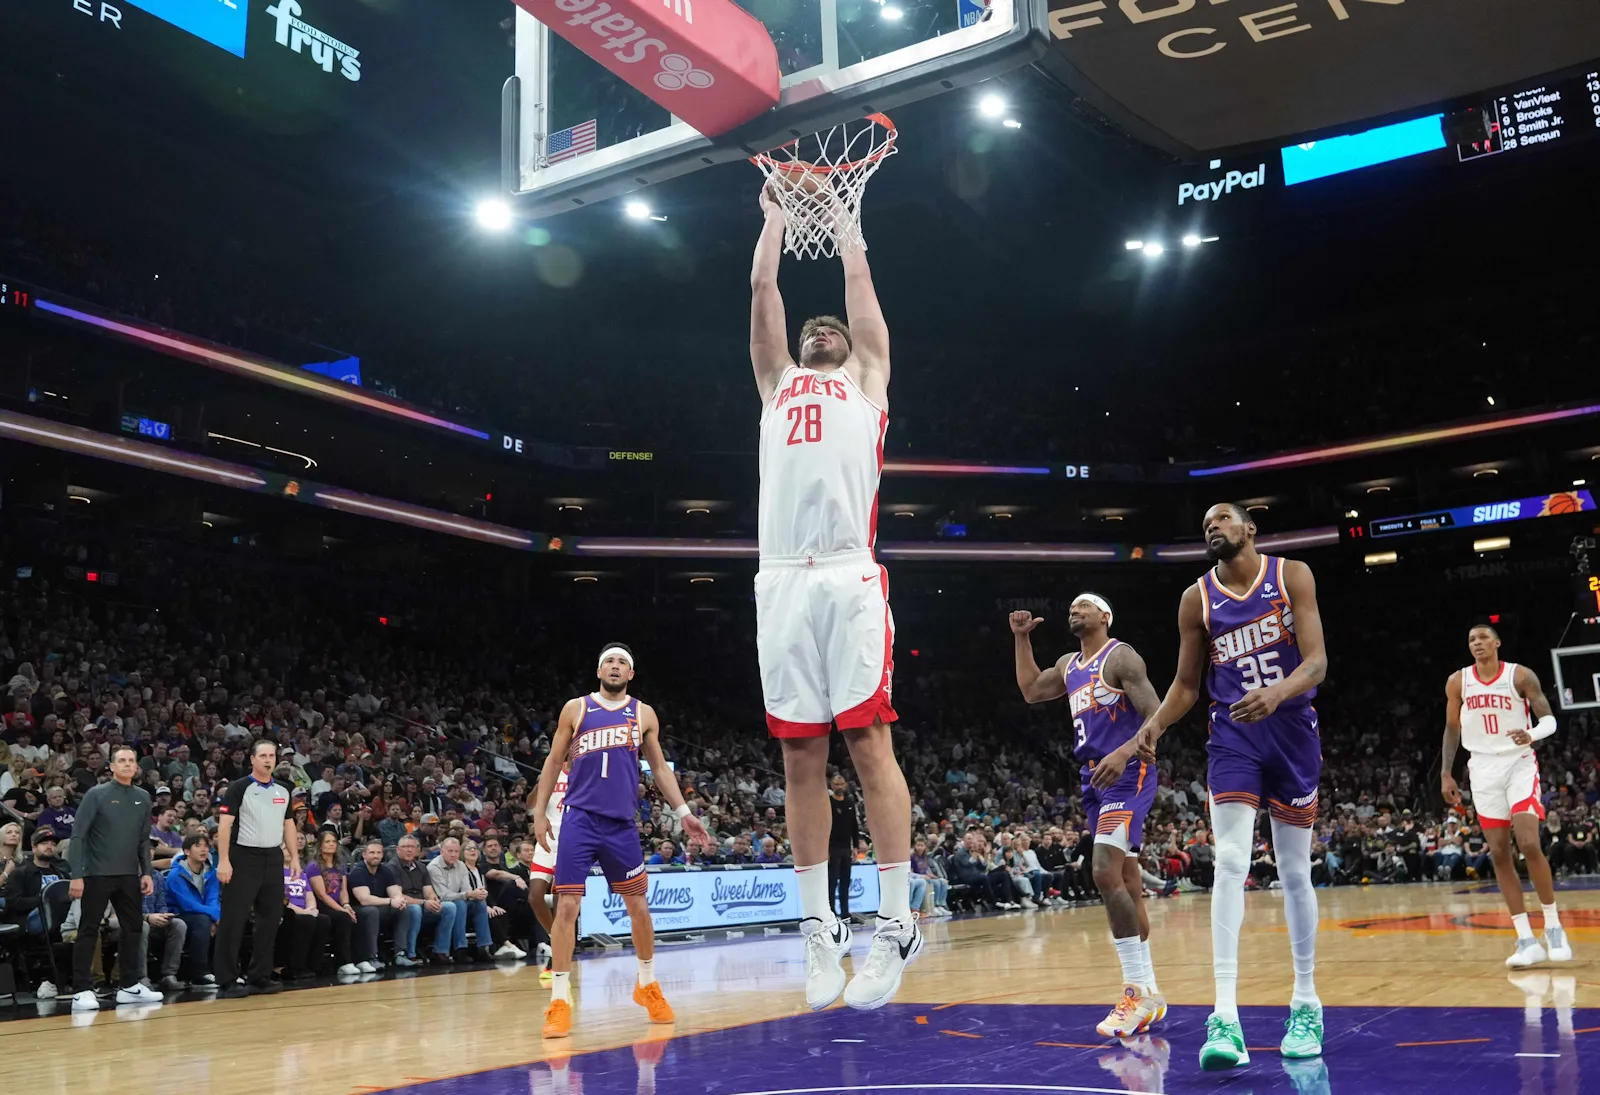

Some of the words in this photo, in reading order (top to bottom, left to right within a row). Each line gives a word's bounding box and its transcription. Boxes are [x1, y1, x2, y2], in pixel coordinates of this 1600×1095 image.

[265, 0, 361, 82] fry's
[291, 18, 317, 37] FOOD
[320, 33, 355, 57] STORES
[1500, 103, 1509, 115] 5
[1514, 91, 1561, 111] VanVleet
[1502, 116, 1511, 126] 9
[1516, 106, 1553, 123] Brooks
[1502, 127, 1516, 138] 10
[1518, 118, 1549, 135] Smith
[1551, 115, 1565, 127] Jr.
[1503, 138, 1518, 151] 28
[1520, 129, 1561, 147] Sengun
[1178, 163, 1266, 206] PayPal
[14, 290, 28, 308] 11
[787, 404, 822, 446] 28
[503, 435, 524, 453] DE
[609, 451, 653, 461] DEFENSE!
[1065, 465, 1089, 478] DE
[1473, 501, 1521, 523] SUNS
[1349, 526, 1364, 539] 11
[1261, 590, 1279, 599] PayPal
[1215, 614, 1281, 663] SUNS
[1236, 650, 1285, 692] 35
[1466, 693, 1512, 711] ROCKETS
[1073, 717, 1087, 747] 3
[1482, 713, 1499, 735] 10
[579, 726, 629, 755] SUNS
[601, 751, 609, 778] 1
[289, 885, 304, 896] 32
[647, 880, 691, 906] James
[711, 876, 747, 902] Sweet
[745, 876, 784, 900] James
[654, 915, 690, 926] ATTORNEYS
